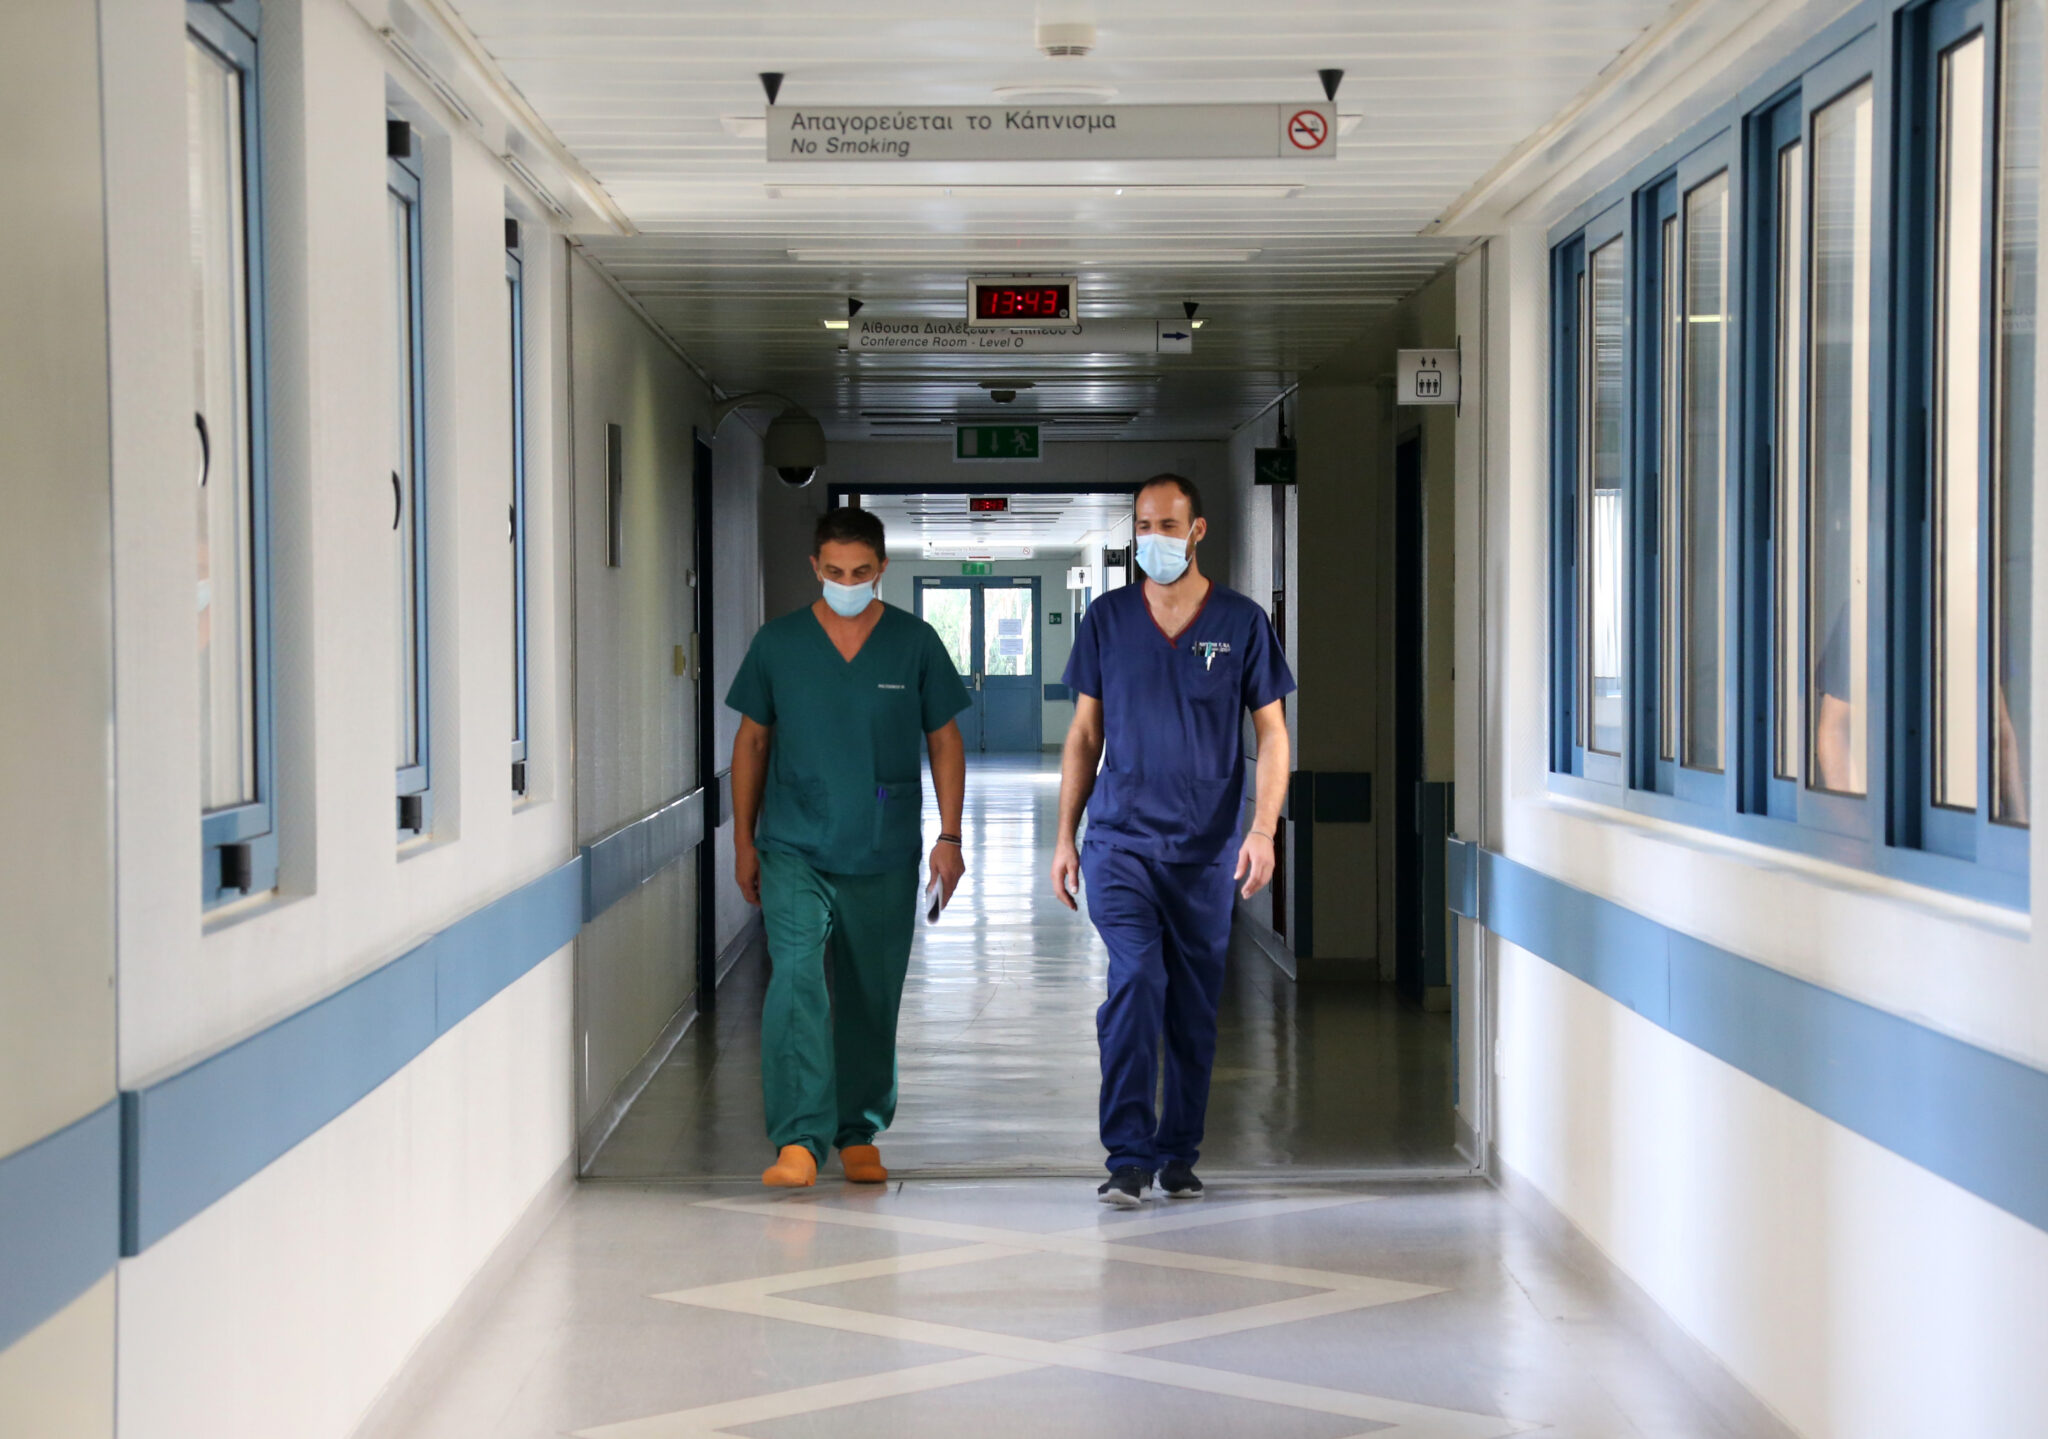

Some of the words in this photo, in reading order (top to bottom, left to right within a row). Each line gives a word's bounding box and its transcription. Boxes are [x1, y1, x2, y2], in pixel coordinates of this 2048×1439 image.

[791, 111, 953, 135] Απαγορεύεται
[966, 115, 992, 130] το
[1005, 110, 1117, 134] Κάπνισμα
[791, 138, 818, 153] No
[825, 137, 910, 157] Smoking
[991, 290, 1058, 315] 13:43
[860, 321, 919, 334] Αίθουσα
[860, 336, 929, 347] Conference
[932, 336, 967, 347] Room
[979, 337, 1011, 347] Level
